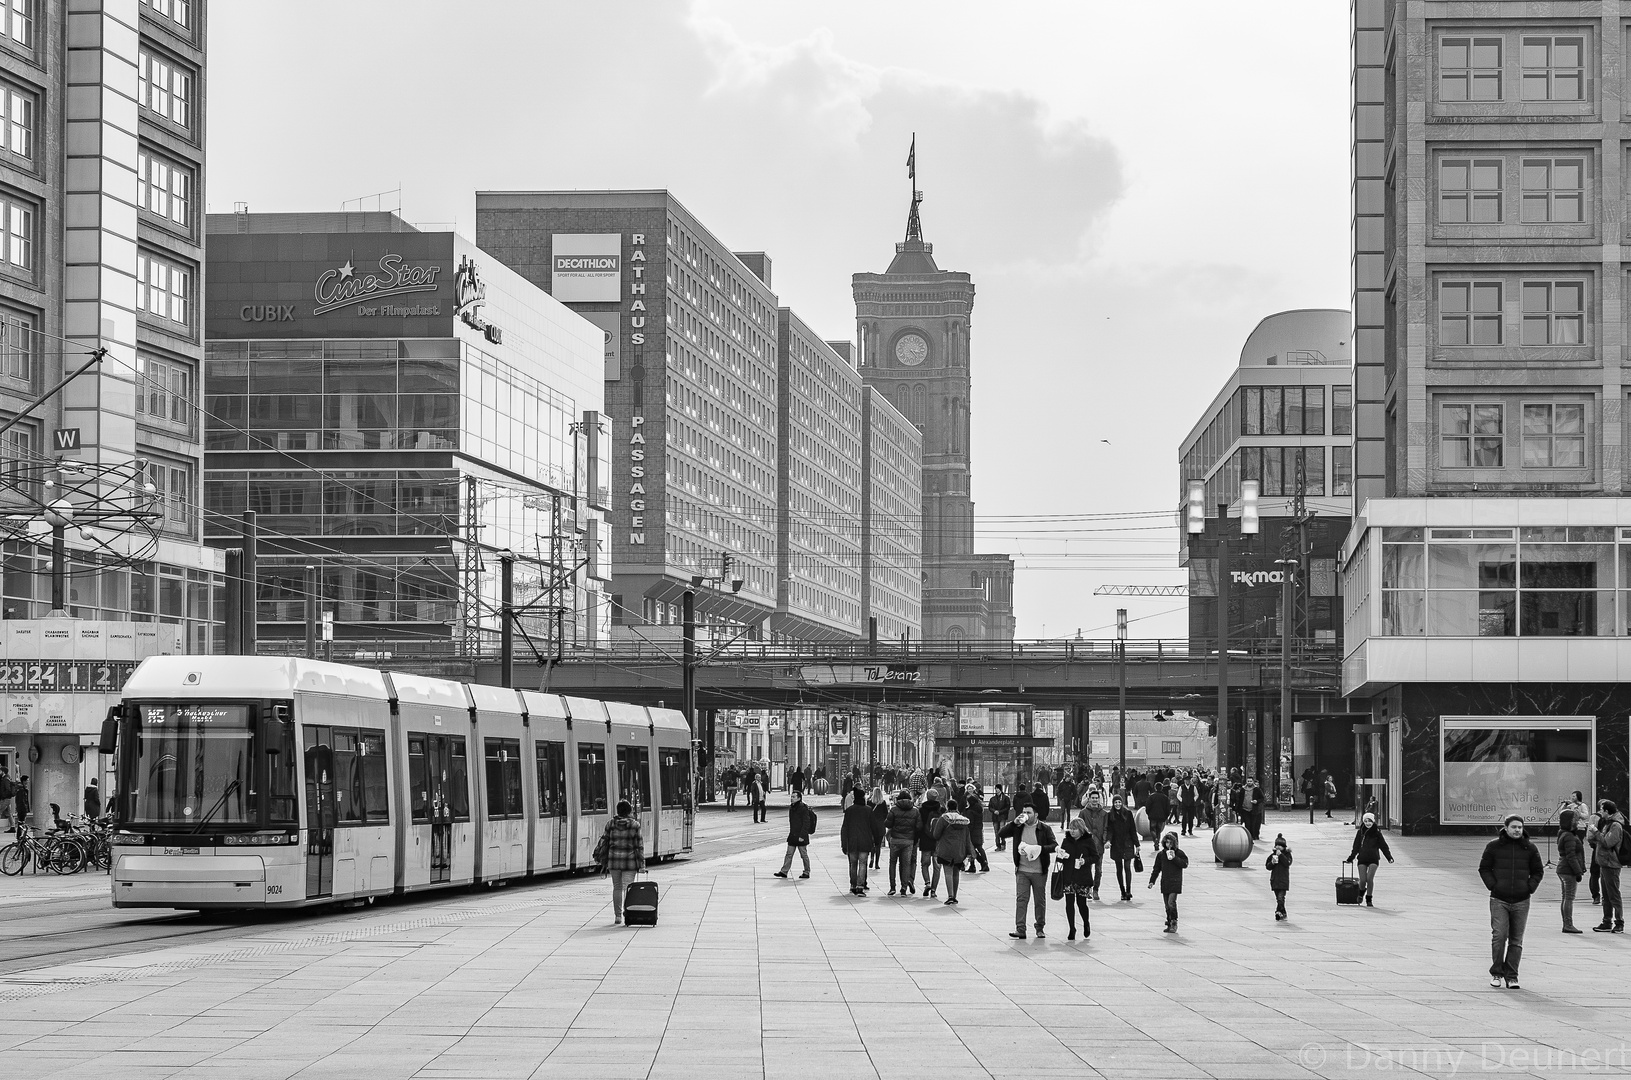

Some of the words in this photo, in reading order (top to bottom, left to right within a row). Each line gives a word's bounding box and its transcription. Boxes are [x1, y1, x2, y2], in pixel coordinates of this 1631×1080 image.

[557, 259, 616, 269] DECATHLON
[314, 254, 440, 305] CineStar
[631, 233, 646, 345] RATHAUS
[240, 305, 295, 321] CUBIX
[358, 306, 377, 316] Der
[380, 305, 440, 318] Filmpalast.
[57, 431, 76, 448] W
[630, 416, 645, 544] PASSAGEN
[0, 666, 24, 685] 23
[28, 666, 55, 685] 24
[67, 666, 78, 685] 1
[97, 667, 110, 686] 2
[1511, 792, 1539, 803] Nähe
[1449, 803, 1496, 812] Wohlfühlen
[1529, 806, 1552, 814] Pflege
[267, 885, 283, 895] 9024
